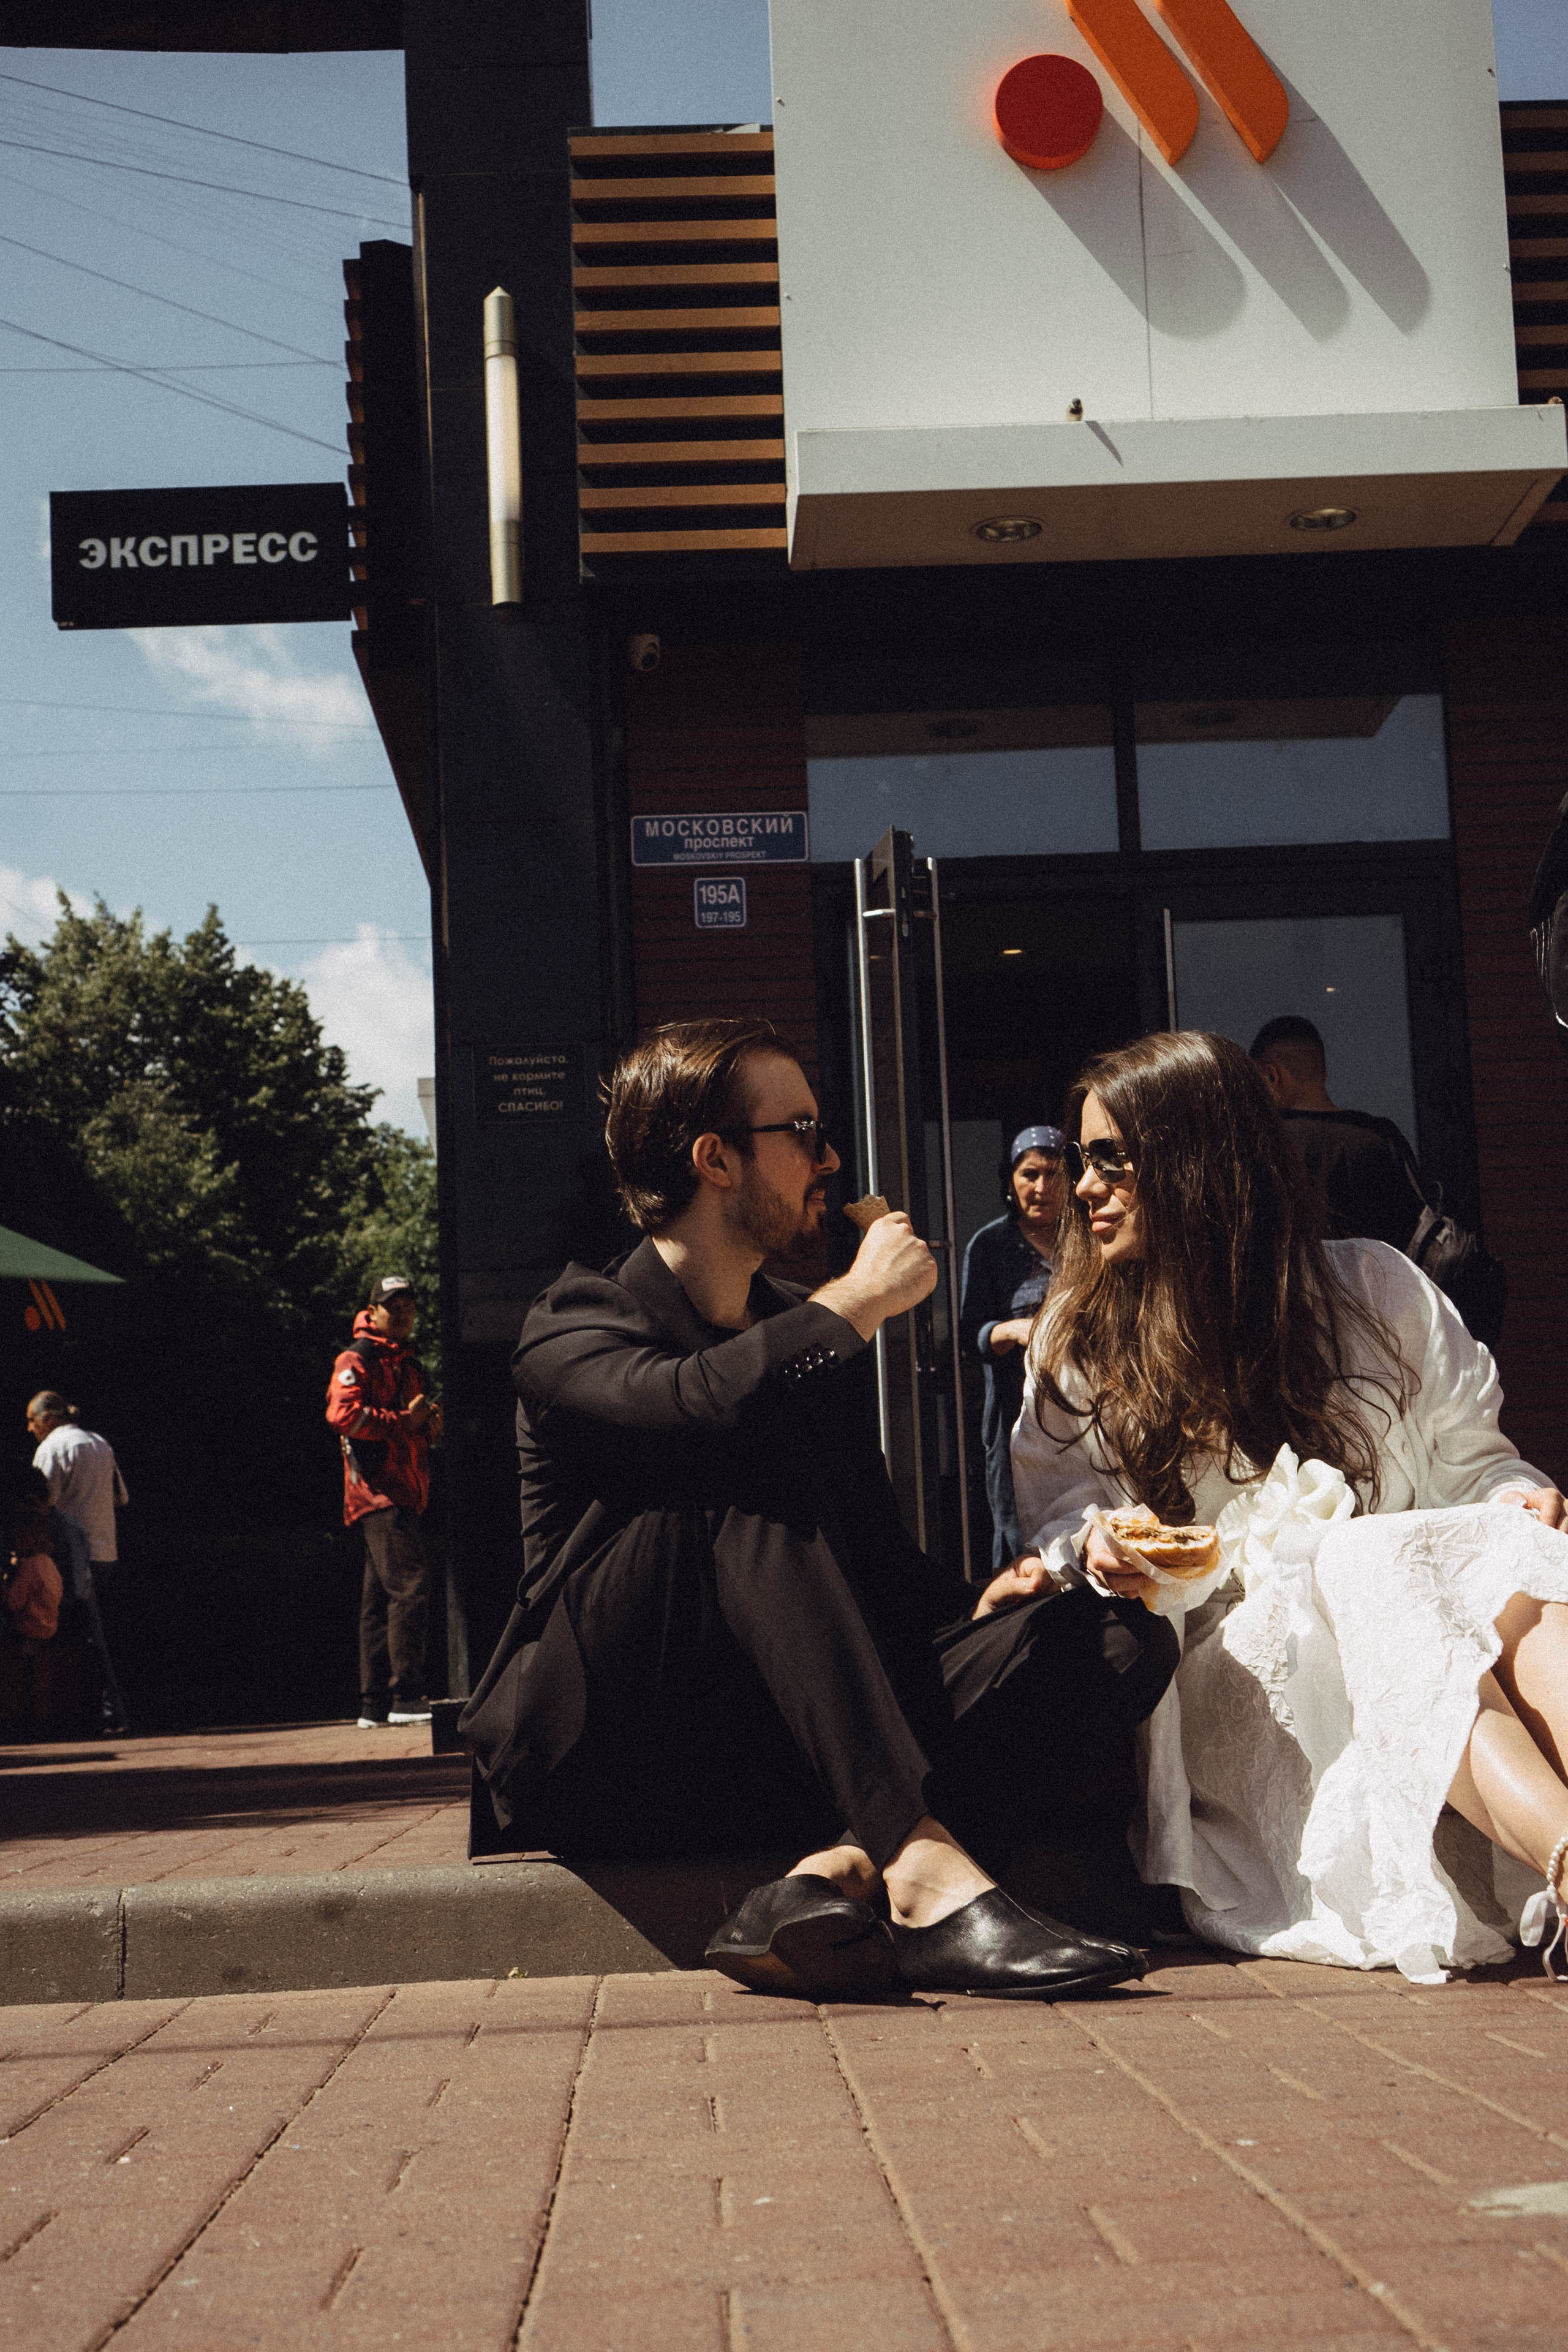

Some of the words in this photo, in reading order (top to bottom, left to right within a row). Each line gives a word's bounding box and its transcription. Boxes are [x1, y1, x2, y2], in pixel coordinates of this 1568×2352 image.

[78, 531, 318, 569] ЭКСПРЕСС
[646, 813, 793, 837] МОСКОВСКИЙ
[684, 836, 755, 852] проспект
[699, 884, 741, 905] 195А
[494, 1073, 508, 1082] не
[511, 1072, 565, 1082] кормите
[498, 1100, 564, 1113] СПАСИБО!
